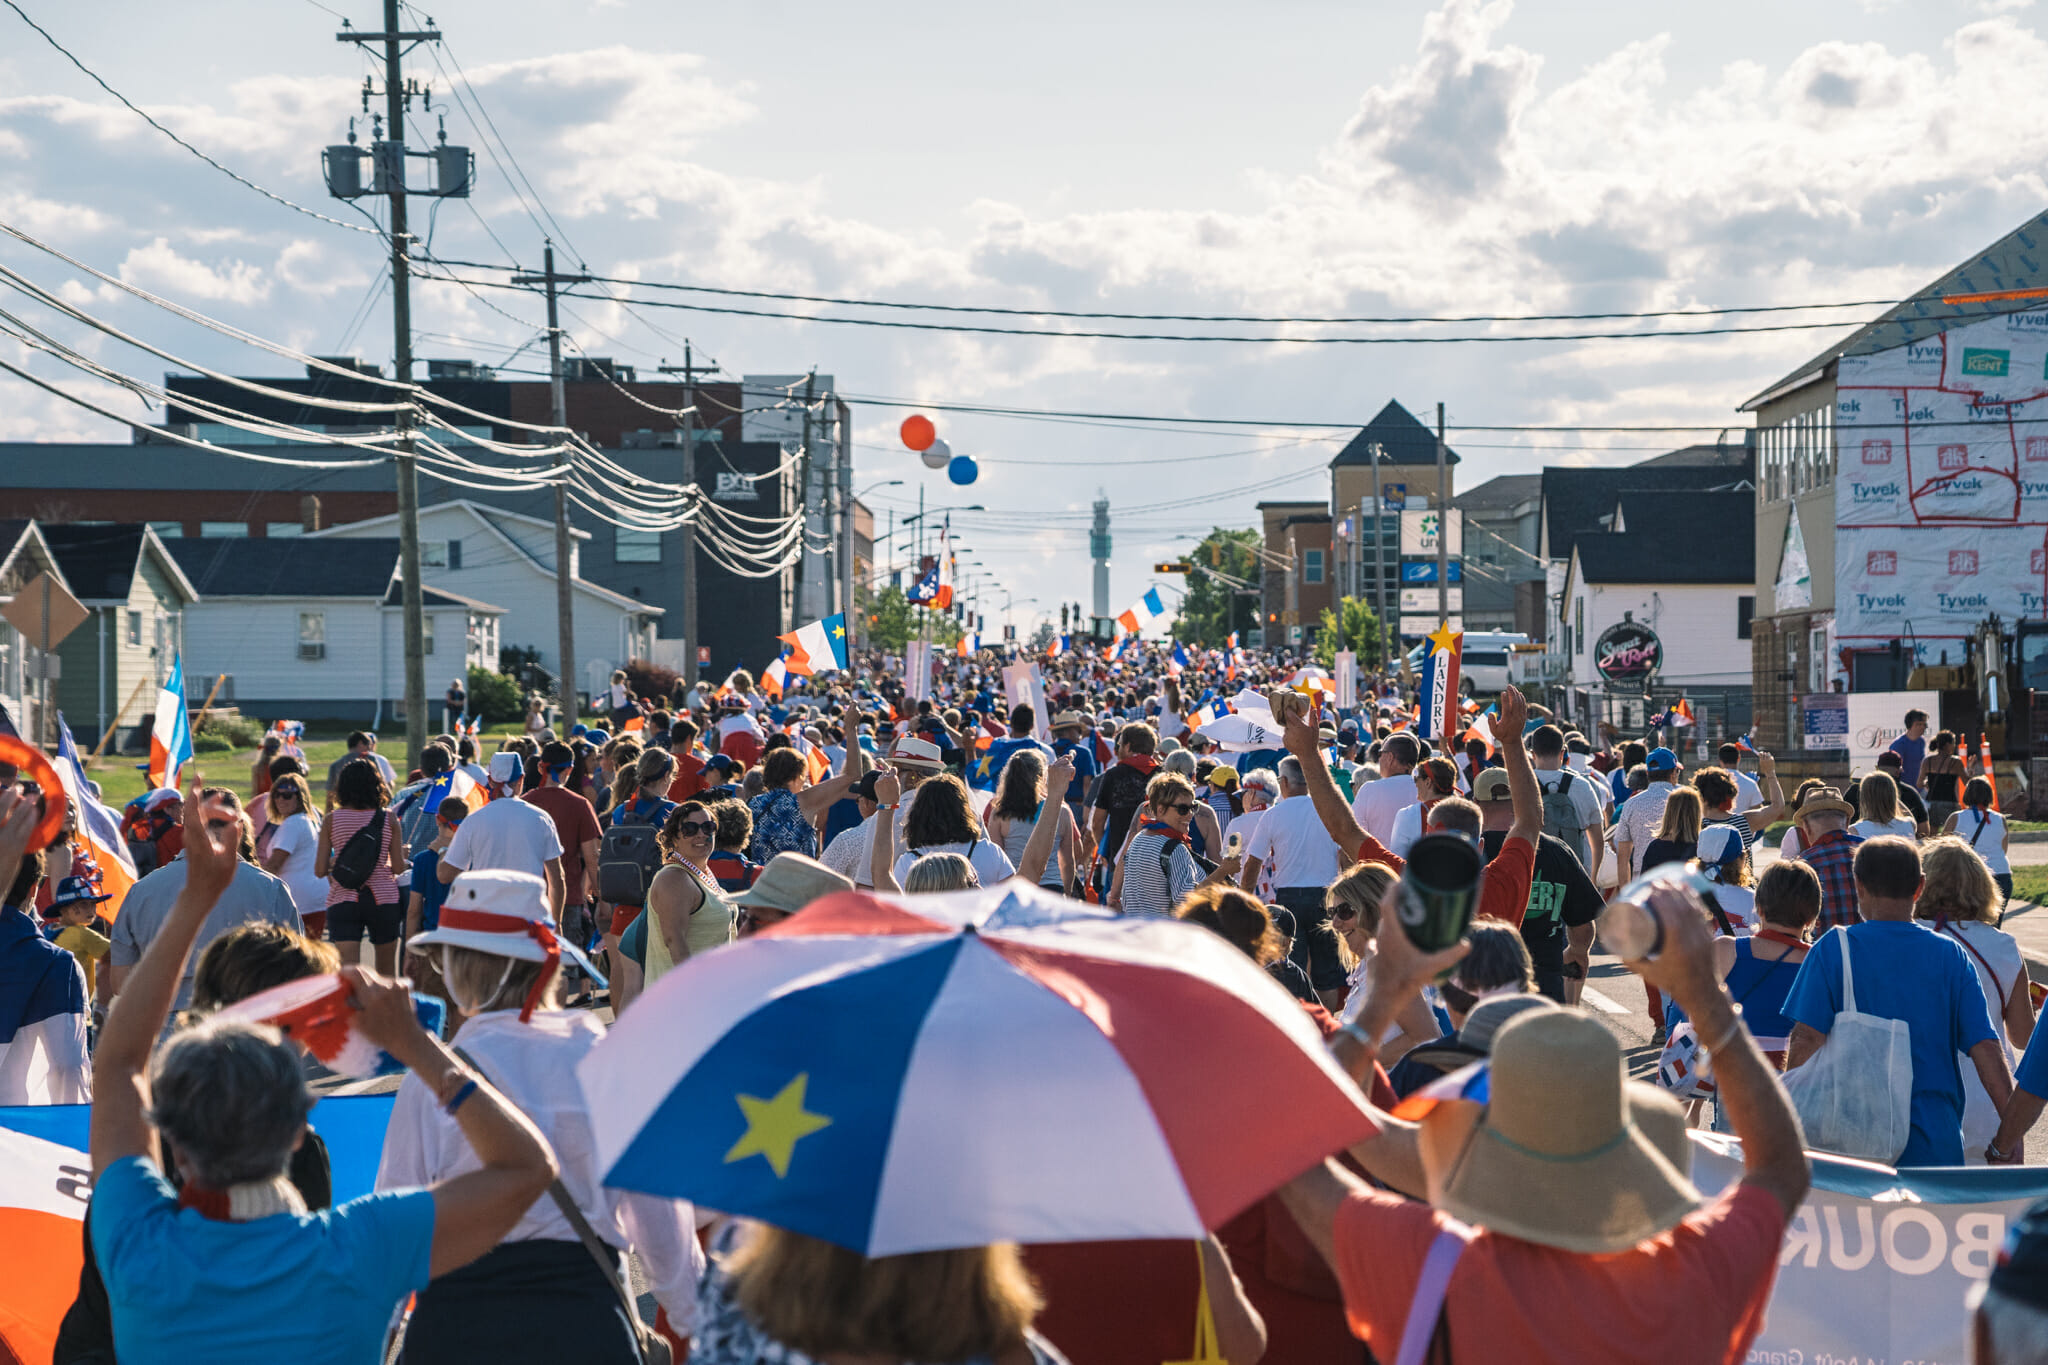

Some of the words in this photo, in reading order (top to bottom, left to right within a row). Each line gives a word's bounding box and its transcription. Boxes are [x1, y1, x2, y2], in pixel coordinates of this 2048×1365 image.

[1906, 343, 1944, 359] Tyve
[1967, 358, 2003, 372] KENT
[1908, 407, 1936, 420] vek
[717, 473, 757, 491] EXIT
[1851, 482, 1901, 497] Tyvek
[1420, 538, 1439, 548] un
[1857, 593, 1906, 609] Tyvek
[1937, 593, 1988, 608] Tyvek
[1433, 656, 1446, 730] LANDRY
